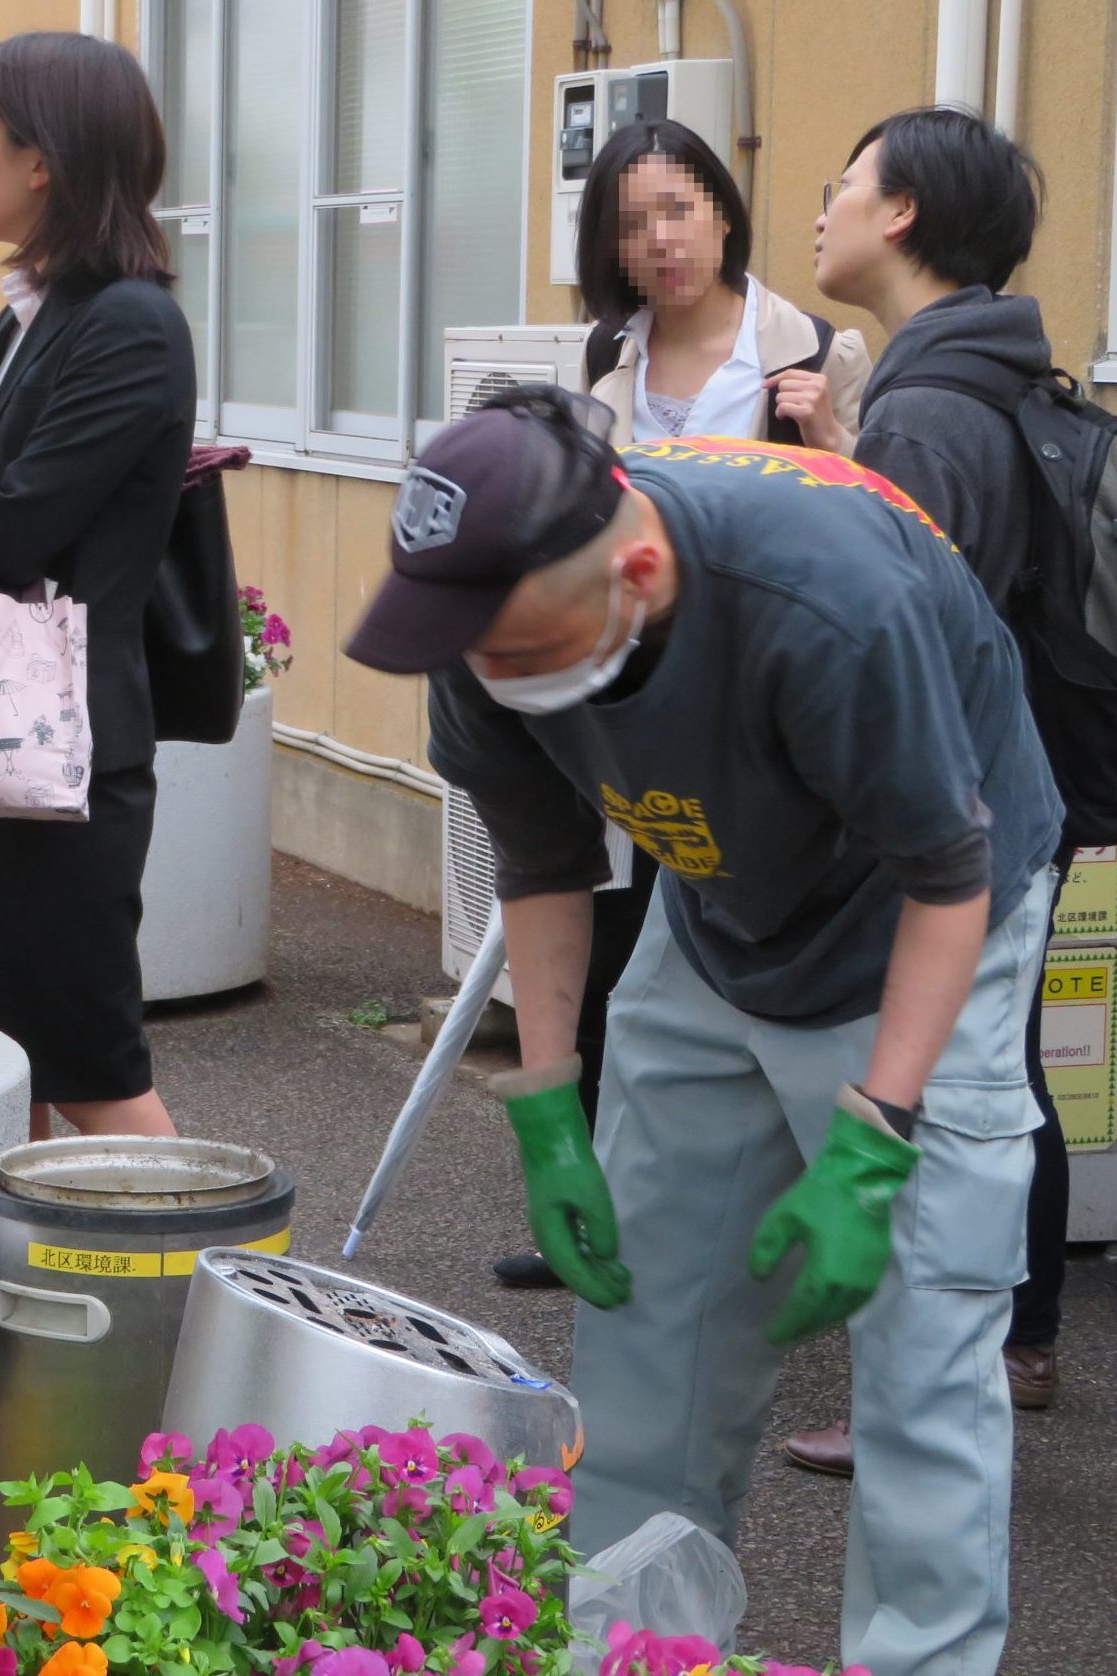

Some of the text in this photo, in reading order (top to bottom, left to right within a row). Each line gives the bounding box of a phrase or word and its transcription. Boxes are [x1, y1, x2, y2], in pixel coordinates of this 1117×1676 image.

[1056, 911, 1108, 923] 北区環境課
[1048, 976, 1104, 994] OTE
[1040, 1045, 1092, 1059] peration!!
